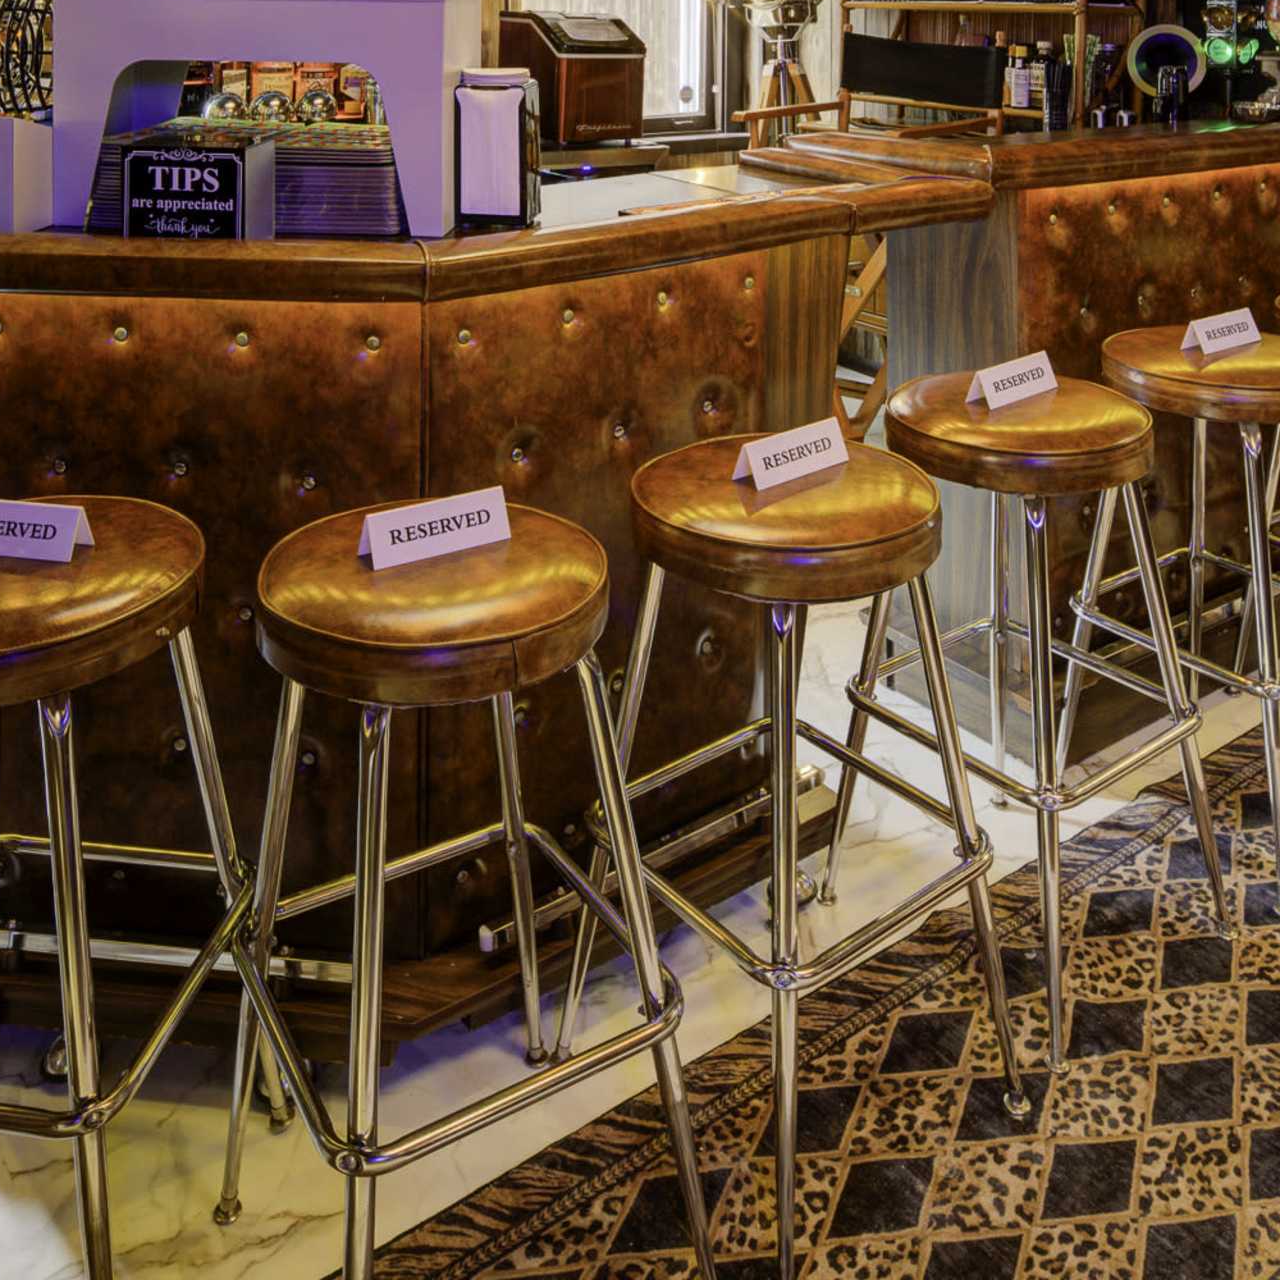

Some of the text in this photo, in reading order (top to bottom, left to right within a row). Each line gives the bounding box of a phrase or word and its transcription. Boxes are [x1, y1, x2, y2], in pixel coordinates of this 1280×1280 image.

[148, 166, 220, 193] TIPS
[132, 198, 234, 212] are appreciated
[152, 216, 213, 239] thank you
[1205, 321, 1249, 340] RESERVED
[992, 367, 1045, 393] RESERVED
[762, 437, 832, 470] RESERVED
[389, 509, 491, 546] RESERVED
